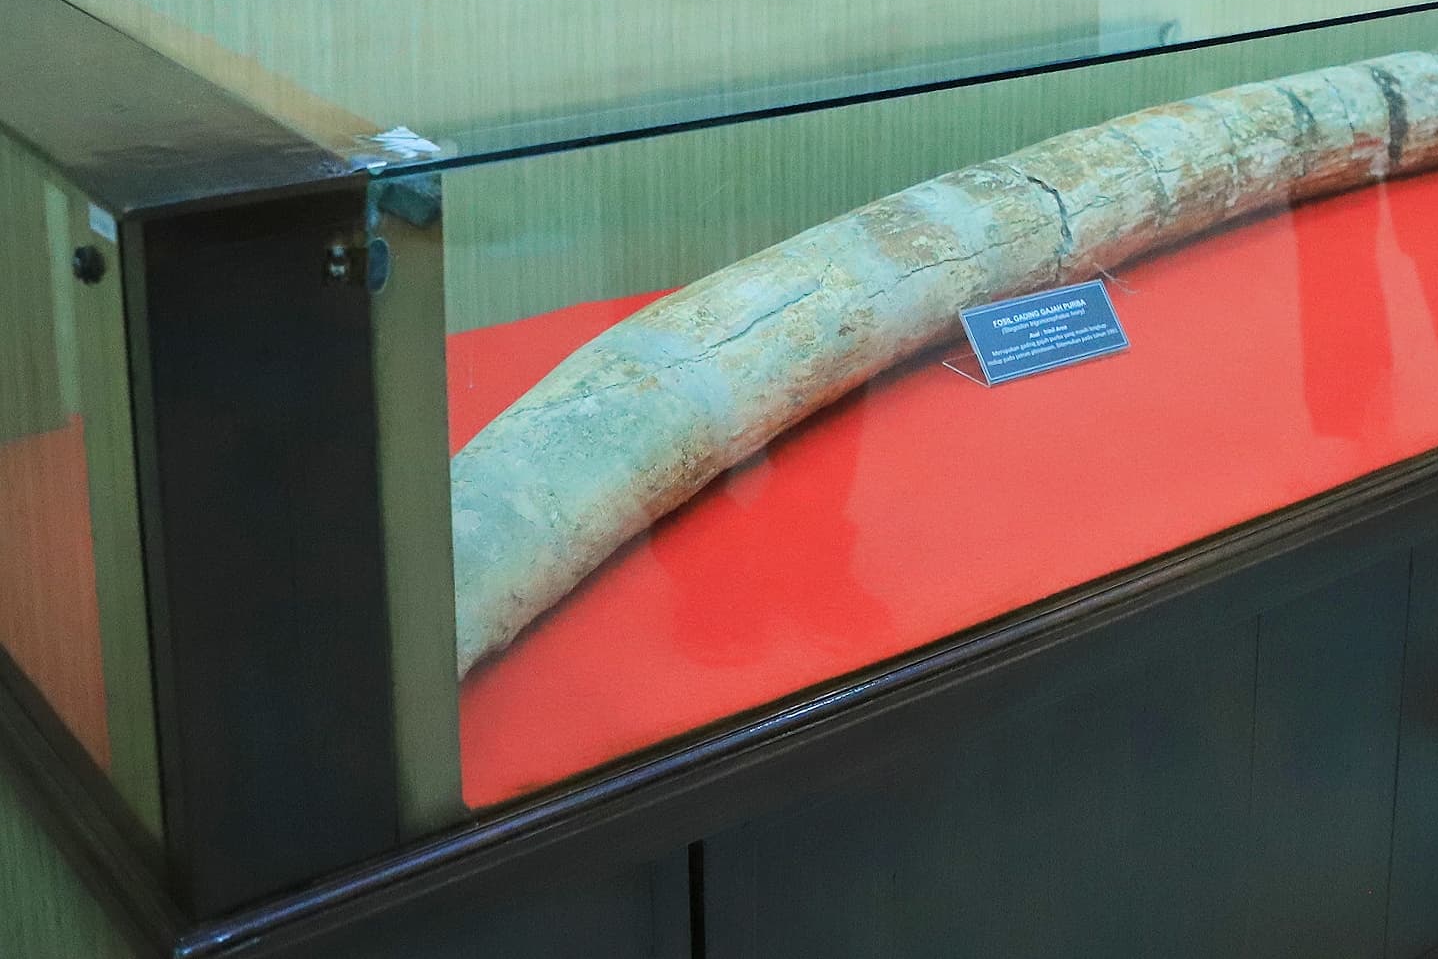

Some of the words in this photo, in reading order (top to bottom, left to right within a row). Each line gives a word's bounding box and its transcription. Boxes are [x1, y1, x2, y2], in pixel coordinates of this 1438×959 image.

[992, 317, 1013, 328] FOSIL
[1013, 310, 1040, 322] GADING
[1040, 304, 1063, 316] GAJAH
[1062, 298, 1087, 311] PURBA
